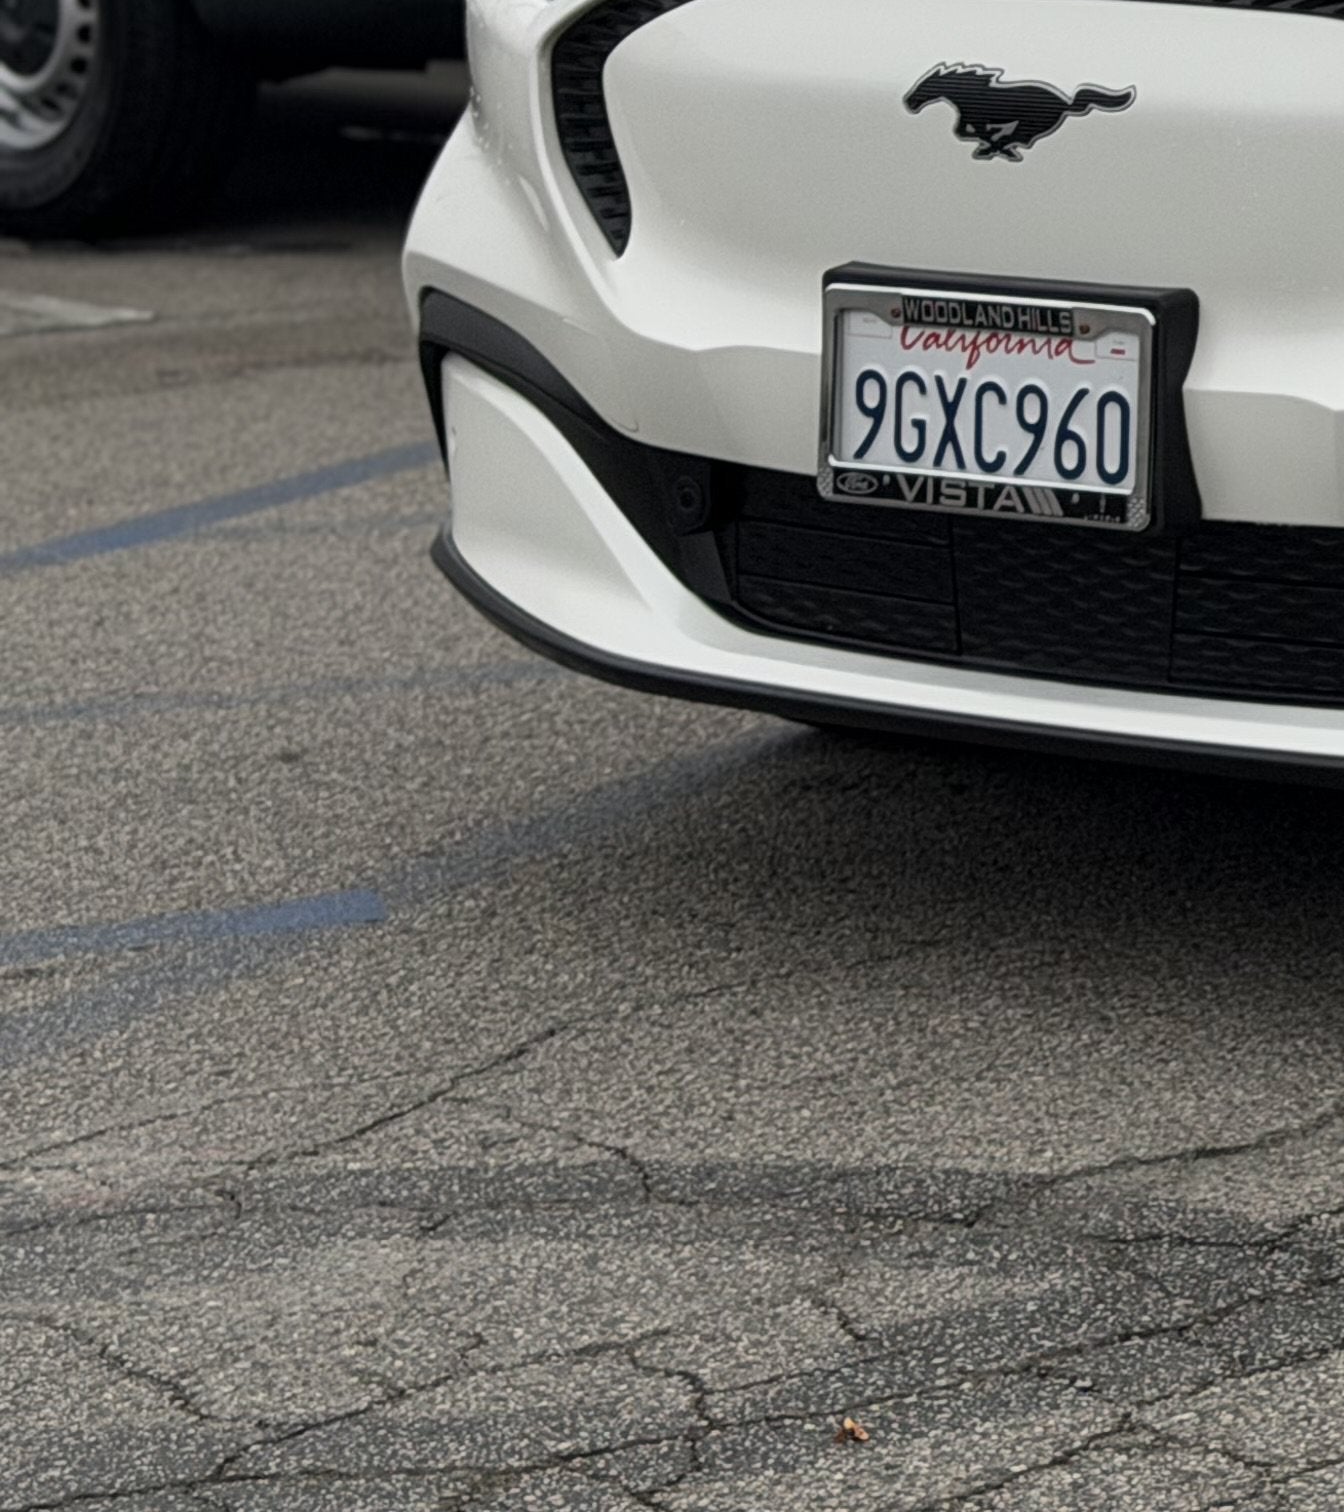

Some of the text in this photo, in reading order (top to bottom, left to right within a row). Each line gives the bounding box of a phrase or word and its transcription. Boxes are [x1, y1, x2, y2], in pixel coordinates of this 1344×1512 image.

[903, 297, 1073, 335] WOODLAND HILLS
[899, 325, 1096, 370] California
[853, 368, 1131, 485] 9GXC960
[897, 474, 1025, 514] VISTA
